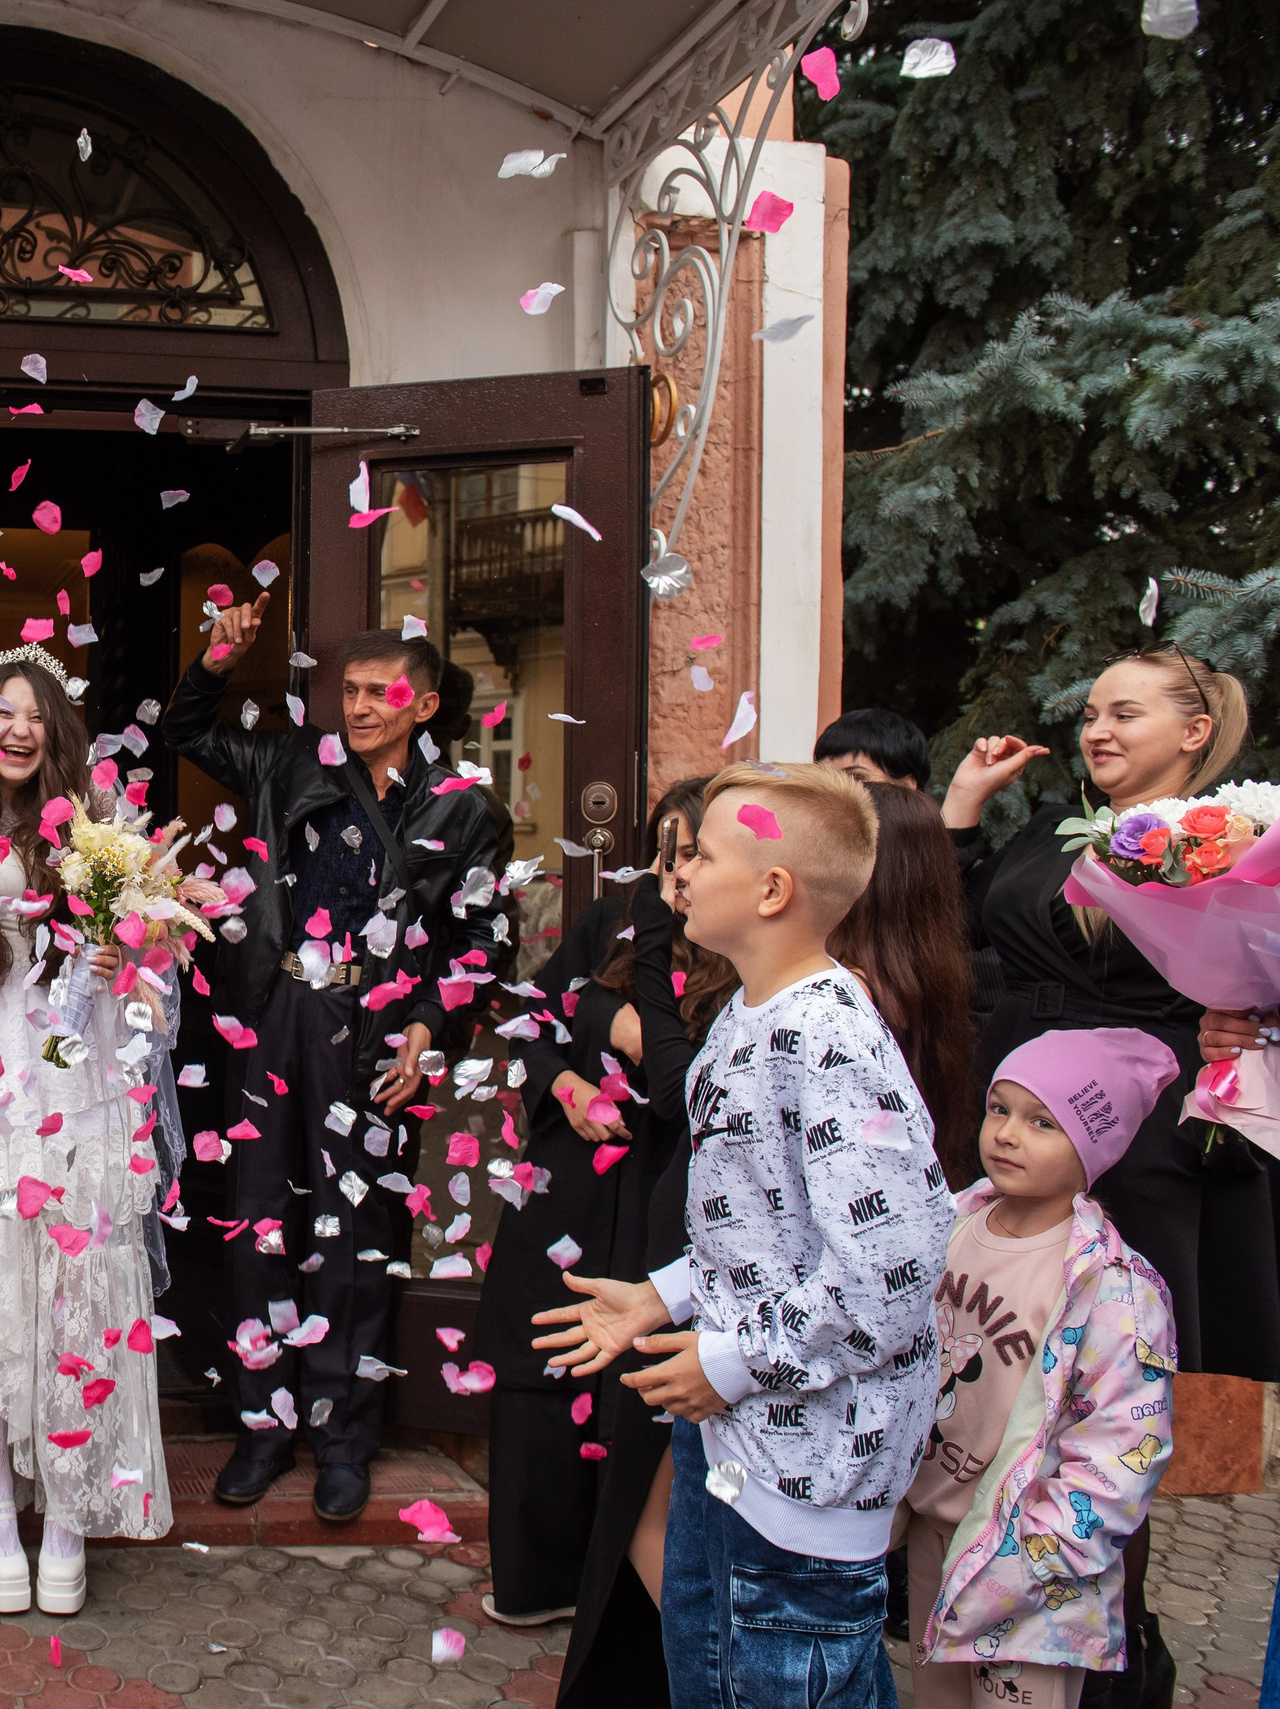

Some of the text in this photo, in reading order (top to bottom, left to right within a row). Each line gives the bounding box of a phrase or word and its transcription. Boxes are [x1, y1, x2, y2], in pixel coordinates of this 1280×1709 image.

[728, 1042, 757, 1068] NIKE
[770, 1028, 802, 1055] NIKE
[688, 1074, 729, 1131] NIKE
[1067, 1079, 1099, 1105] BELIEVE
[726, 1111, 754, 1138] NIKE
[805, 1117, 842, 1154] NIKE
[1073, 1103, 1098, 1145] YOURSELF
[702, 1195, 732, 1222] NIKE
[848, 1189, 890, 1226] NIKE
[728, 1262, 762, 1290] NIKE
[883, 1258, 921, 1295] NIKE
[935, 1270, 1035, 1366] NNIE
[767, 1403, 805, 1428] NIKE
[851, 1428, 884, 1458] NIKE
[778, 1476, 812, 1499] NIKE
